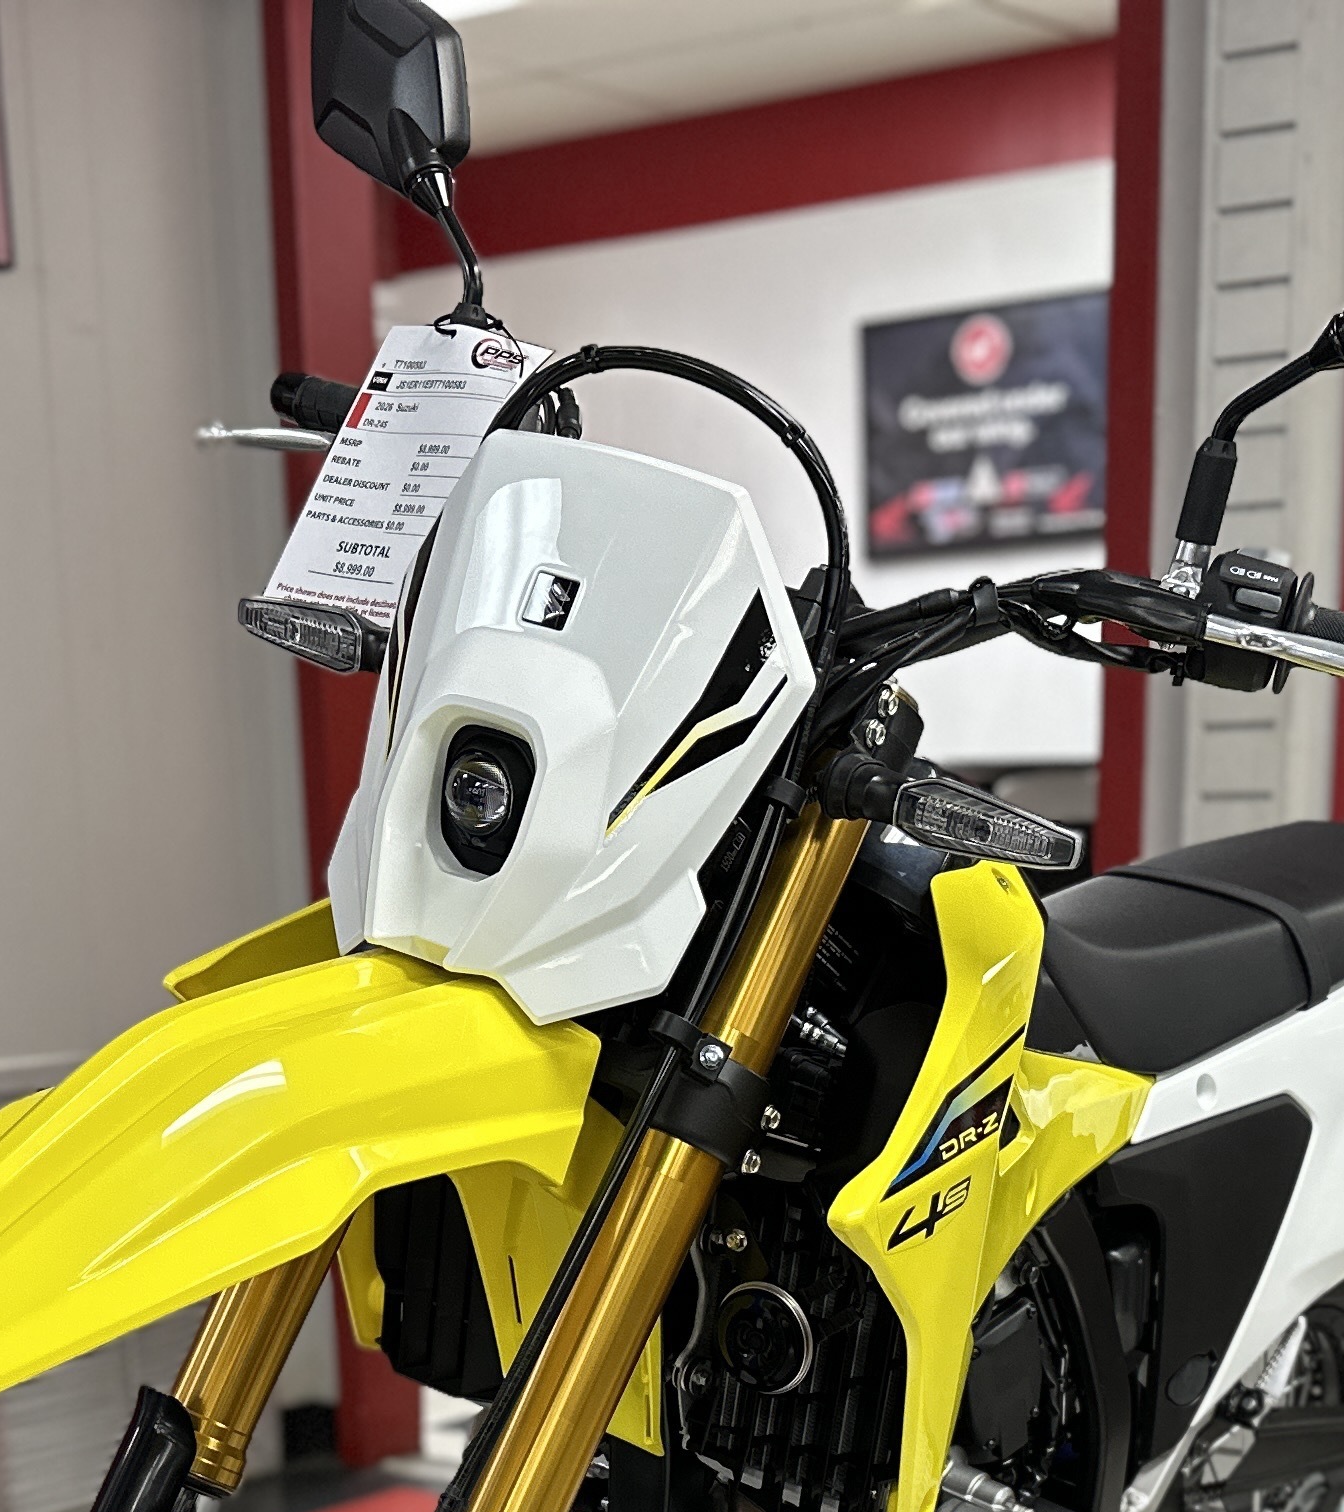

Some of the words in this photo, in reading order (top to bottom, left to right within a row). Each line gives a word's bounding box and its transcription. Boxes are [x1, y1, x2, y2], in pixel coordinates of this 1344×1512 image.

[396, 402, 420, 413] Suzuki
[339, 437, 363, 448] MSRP
[331, 455, 361, 468] REBATE
[410, 461, 429, 472] $0.00
[322, 474, 353, 488] DEALER
[352, 478, 391, 492] DISCOUNT
[401, 482, 421, 494] $0.00
[314, 492, 333, 504] UNIT
[332, 495, 356, 508] PRICE
[306, 509, 331, 523] PARTS
[330, 514, 338, 524] &
[336, 515, 385, 530] ACCESSORIES
[385, 520, 405, 532] $0.00
[336, 540, 391, 559] SUBTOTAL
[333, 560, 376, 578] $8,999.00
[276, 582, 295, 594] Price
[294, 585, 317, 598] shown
[317, 590, 333, 601] does
[333, 594, 346, 603] not
[939, 1111, 999, 1161] DR-Z
